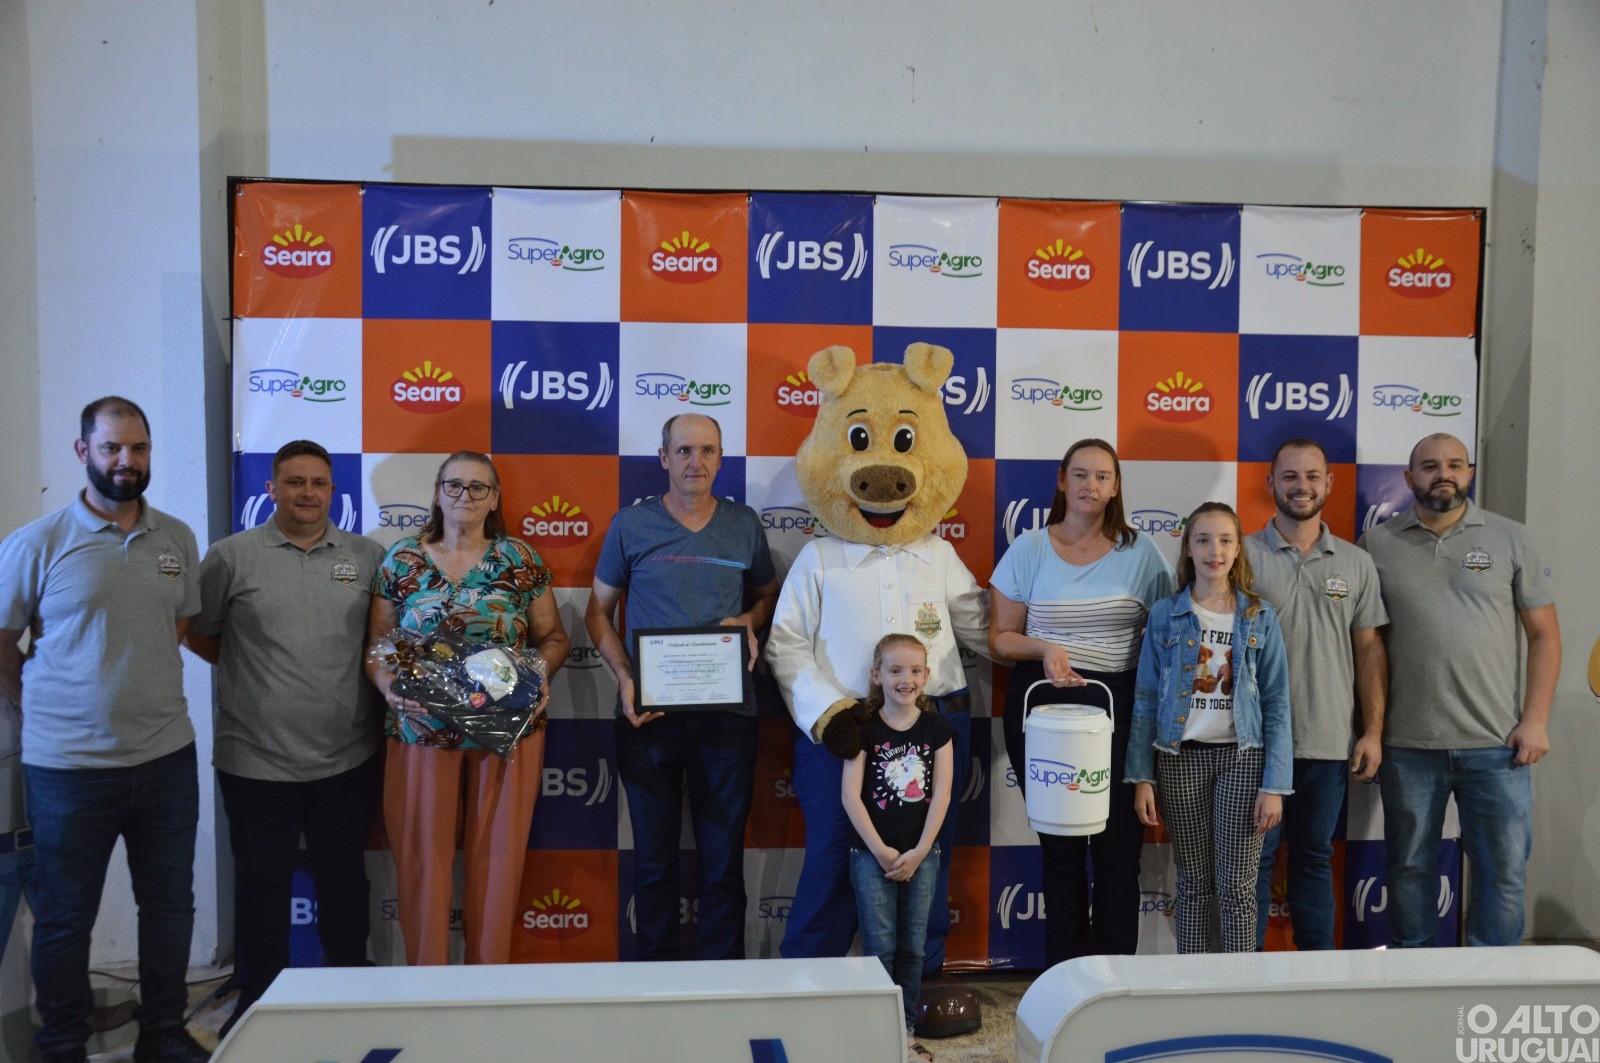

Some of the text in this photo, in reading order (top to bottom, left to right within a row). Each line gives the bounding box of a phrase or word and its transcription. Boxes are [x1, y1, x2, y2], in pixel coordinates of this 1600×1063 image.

[264, 247, 332, 267] Seara
[507, 244, 605, 265] SuperAgro
[651, 252, 718, 273] Seara
[888, 250, 983, 271] SuperAgro
[1027, 260, 1091, 280] Seara
[1388, 268, 1451, 288] Seara
[249, 376, 346, 396] SuperAgro
[393, 382, 461, 403] Seara
[635, 379, 731, 400] SuperAgro
[777, 386, 823, 406] Sear
[1011, 384, 1103, 404] SuperAgro
[1147, 392, 1210, 413] Seara
[1372, 390, 1462, 410] SuperAgro
[378, 511, 431, 531] Super
[522, 517, 588, 536] Seara
[542, 767, 588, 797] BS
[523, 910, 588, 929] Seara
